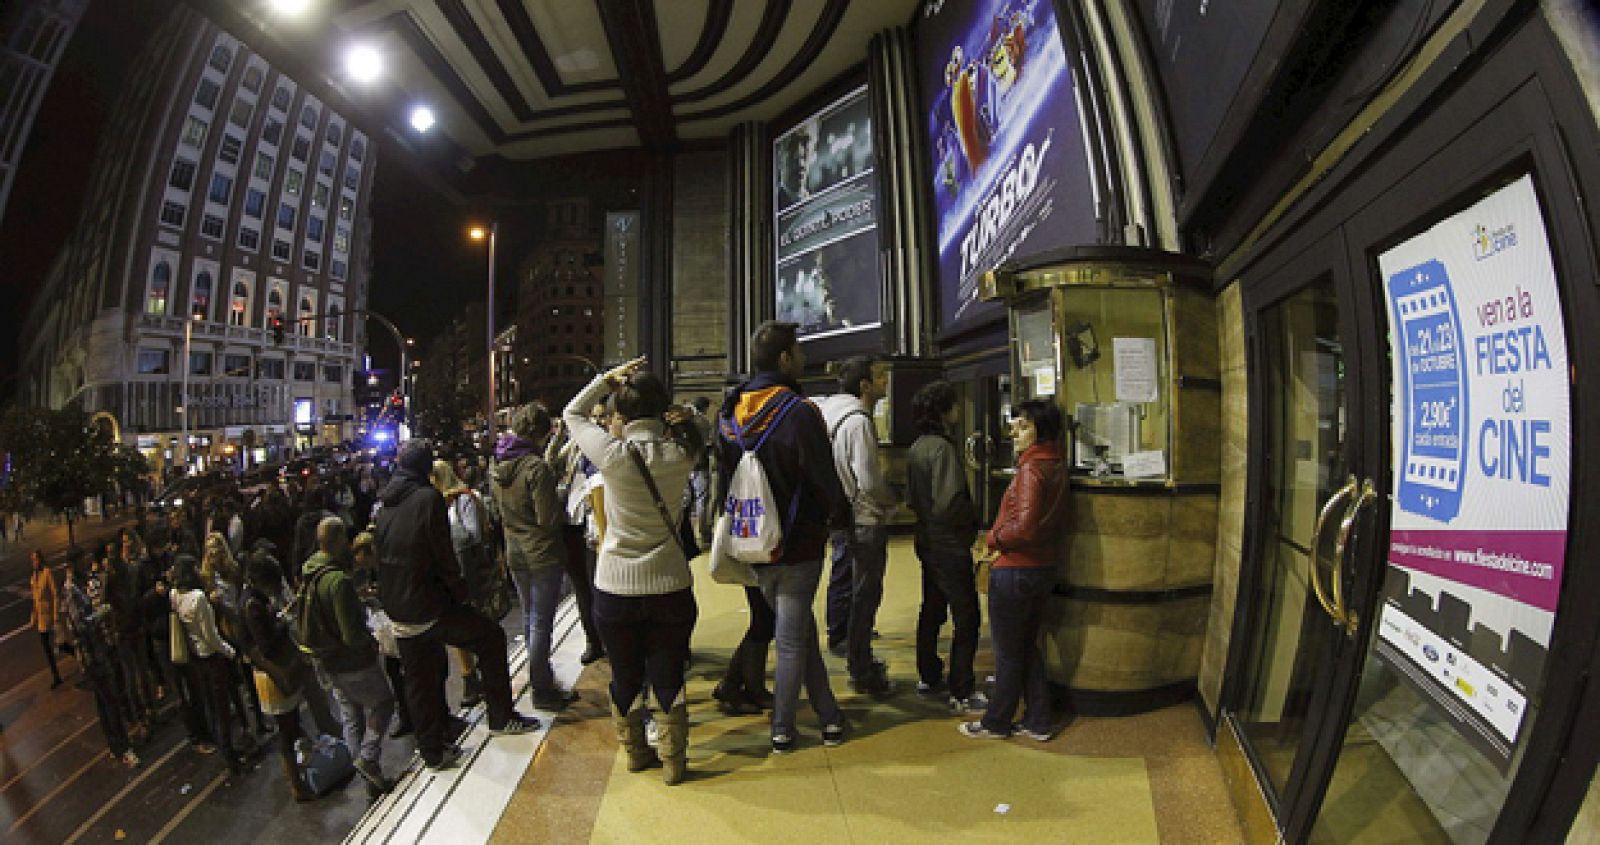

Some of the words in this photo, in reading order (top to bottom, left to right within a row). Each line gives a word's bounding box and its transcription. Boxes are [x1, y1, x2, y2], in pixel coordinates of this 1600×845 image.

[960, 129, 1054, 284] TURBO
[1477, 299, 1503, 328] ven
[1505, 296, 1516, 321] a
[1516, 285, 1533, 318] la
[1474, 324, 1552, 376] FIESTA
[1502, 379, 1524, 413] del
[1479, 417, 1551, 487] CINE
